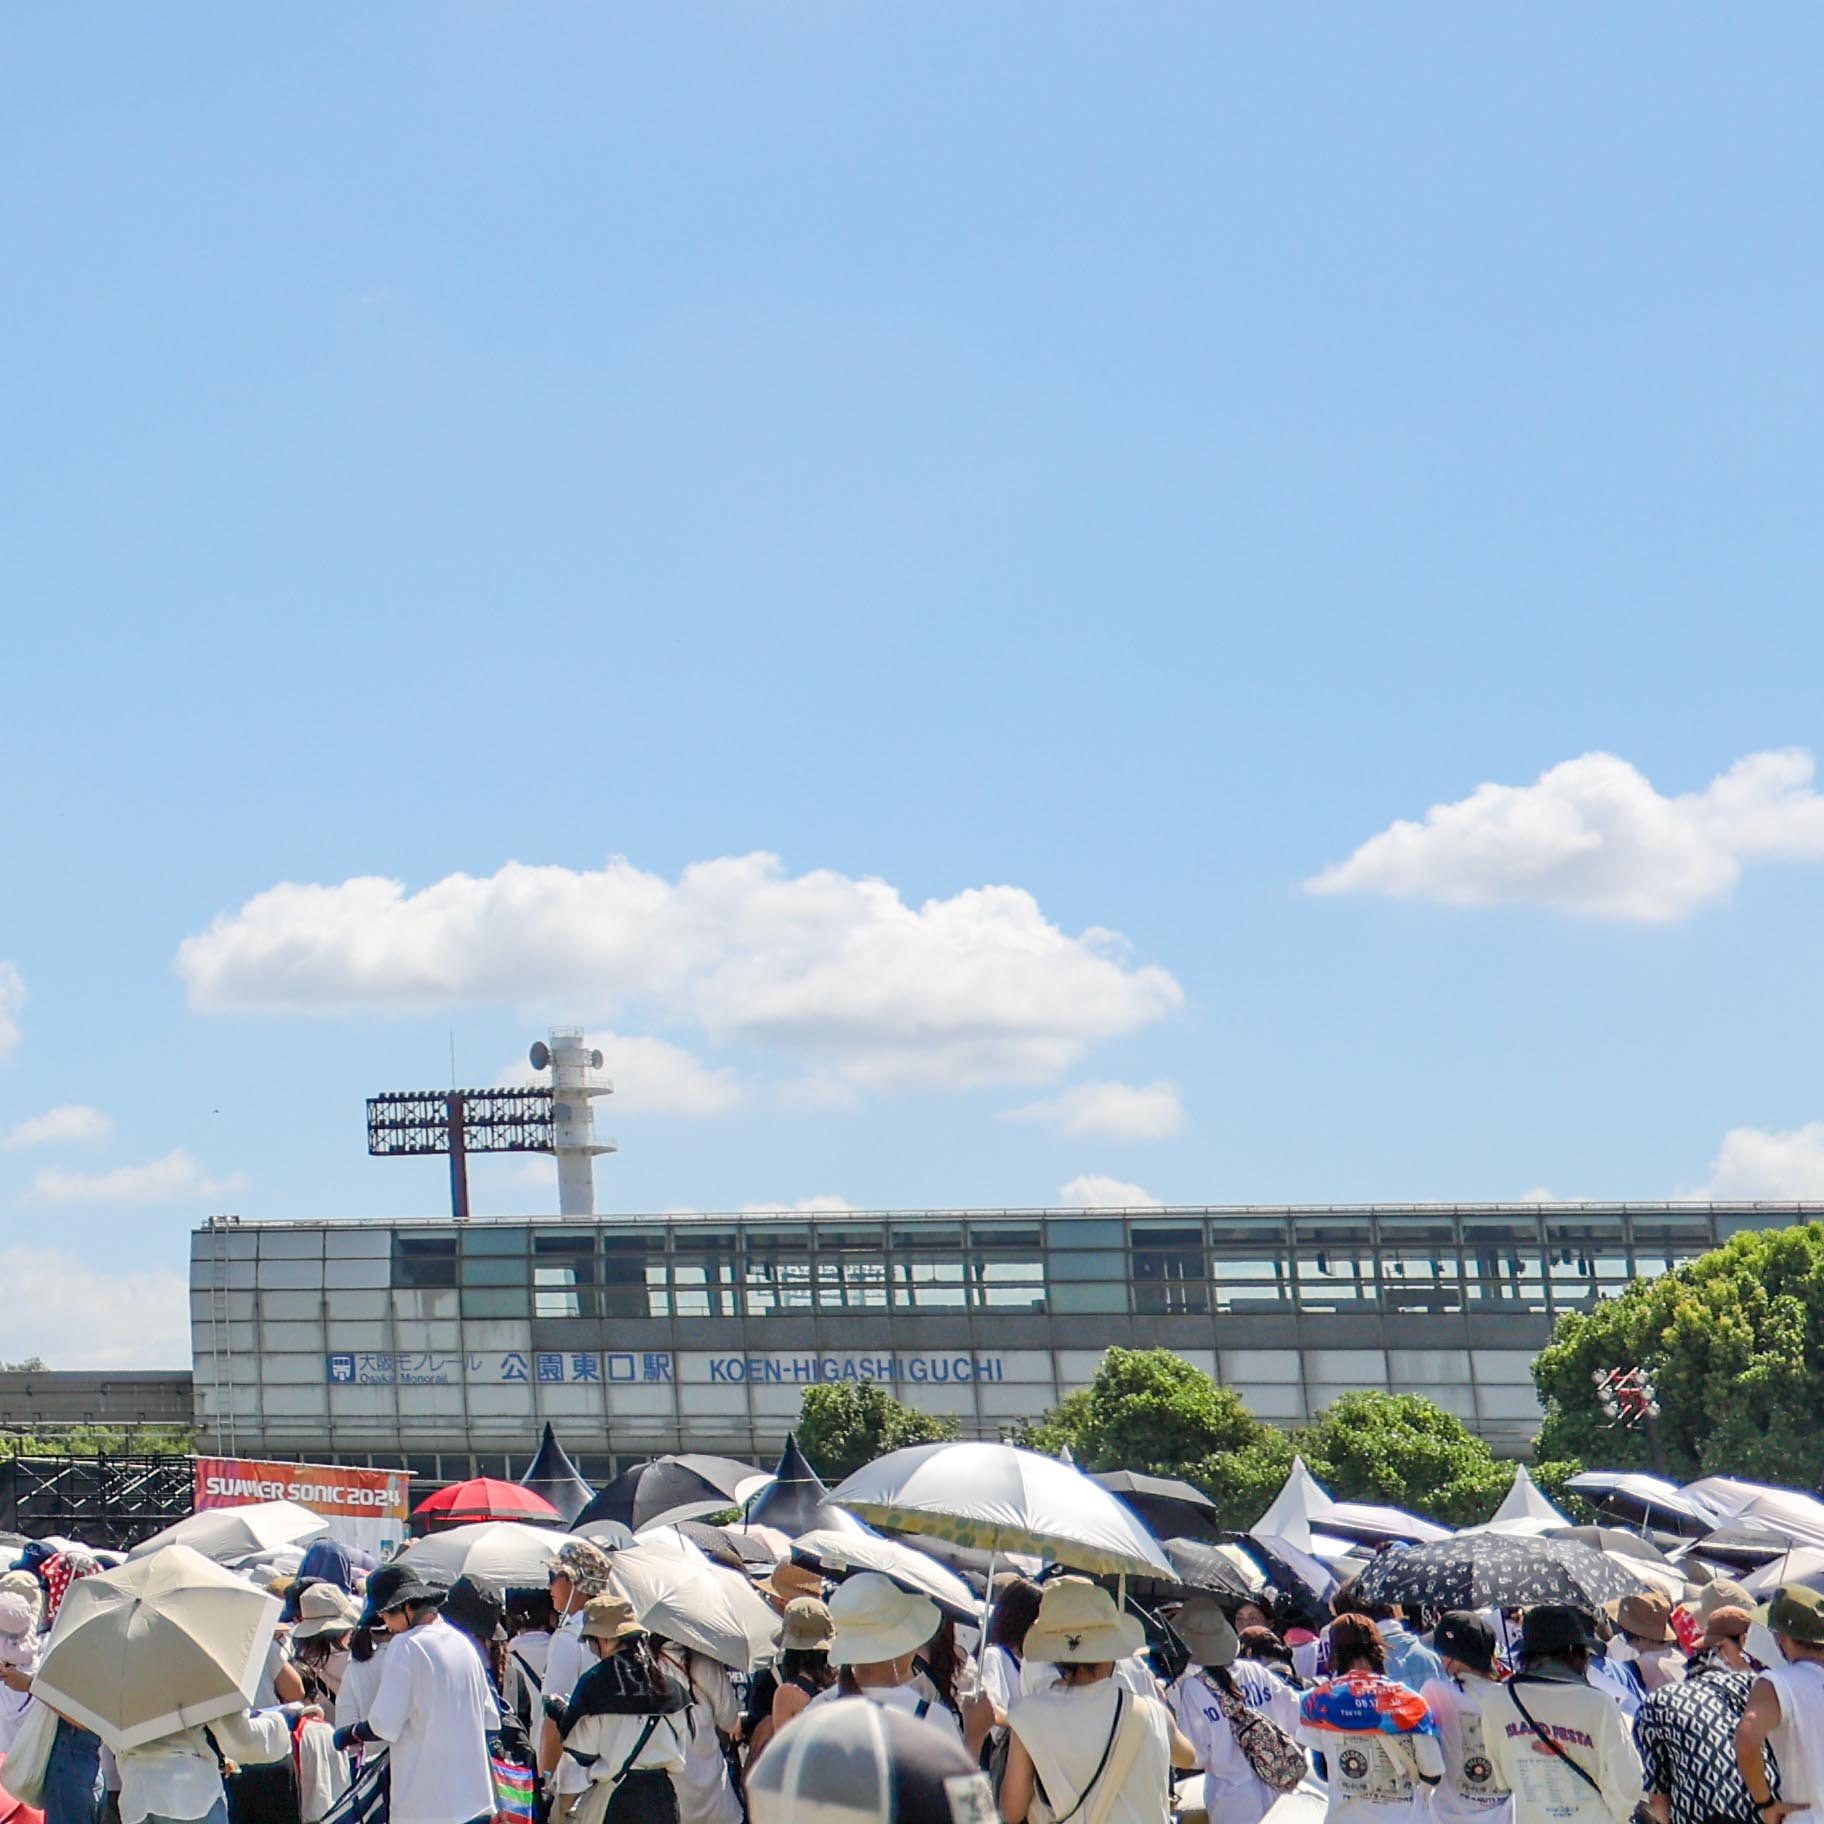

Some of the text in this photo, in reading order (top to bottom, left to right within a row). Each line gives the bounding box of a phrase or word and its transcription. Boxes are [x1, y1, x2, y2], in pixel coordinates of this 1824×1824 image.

[360, 1353, 673, 1382] 大阪モノレール 公園東口駅
[206, 1477, 400, 1506] SUMMER SONIC 2024
